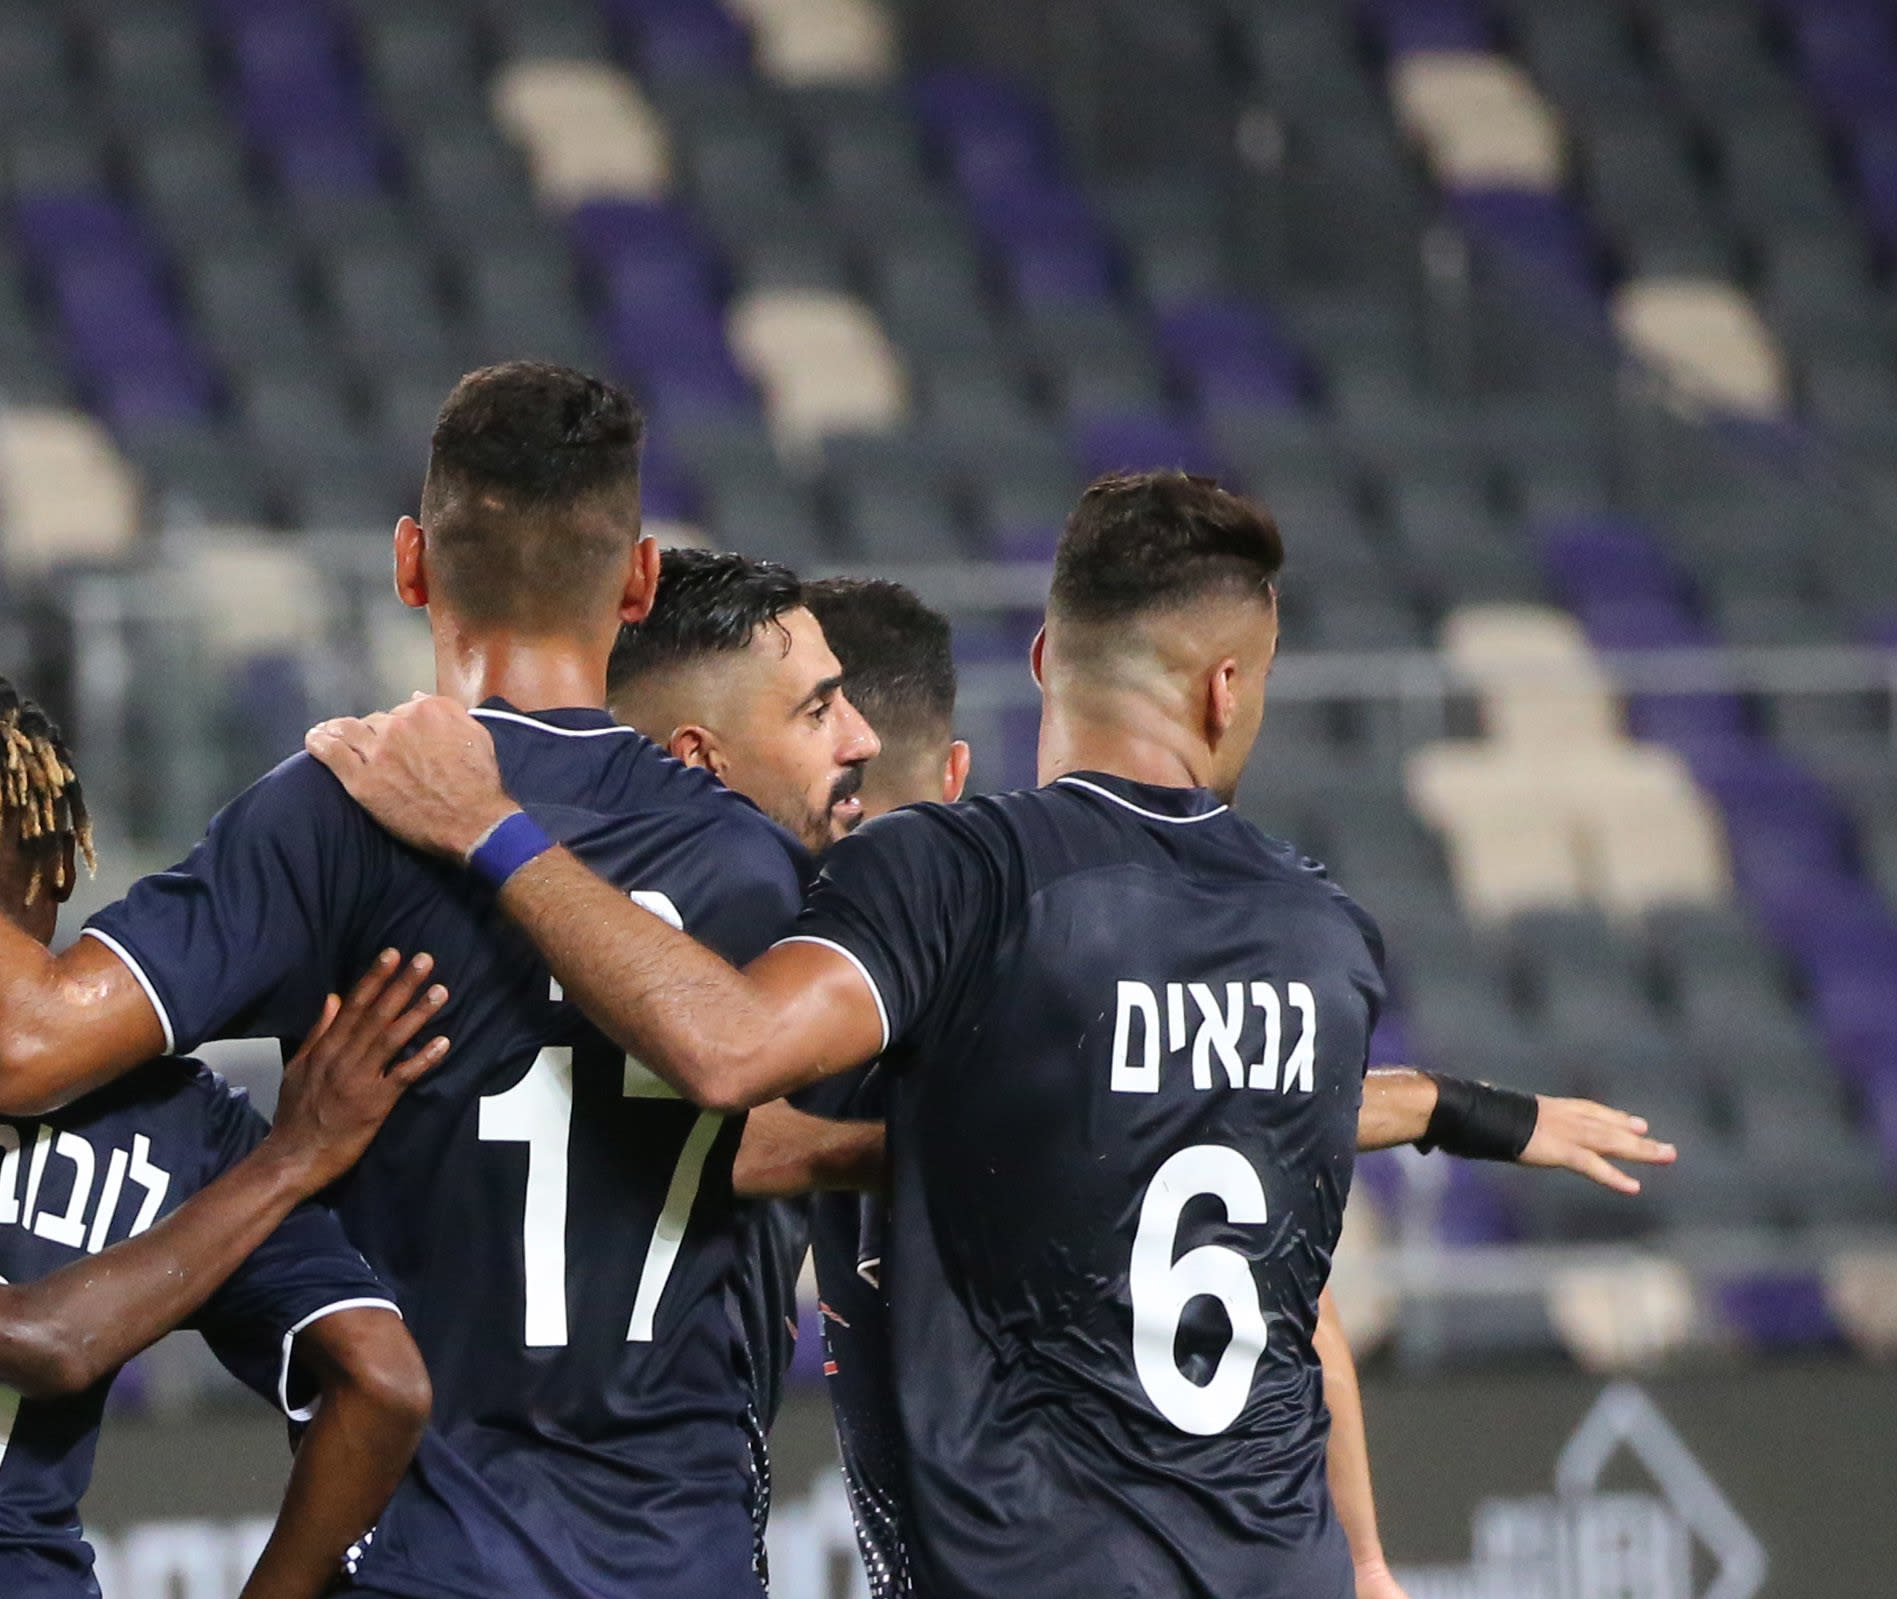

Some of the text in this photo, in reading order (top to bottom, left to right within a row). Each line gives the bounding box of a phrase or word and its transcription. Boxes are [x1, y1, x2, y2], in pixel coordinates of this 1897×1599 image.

[1110, 980, 1318, 1095] גנאים
[477, 1045, 726, 1347] 17
[1129, 1144, 1268, 1436] 6
